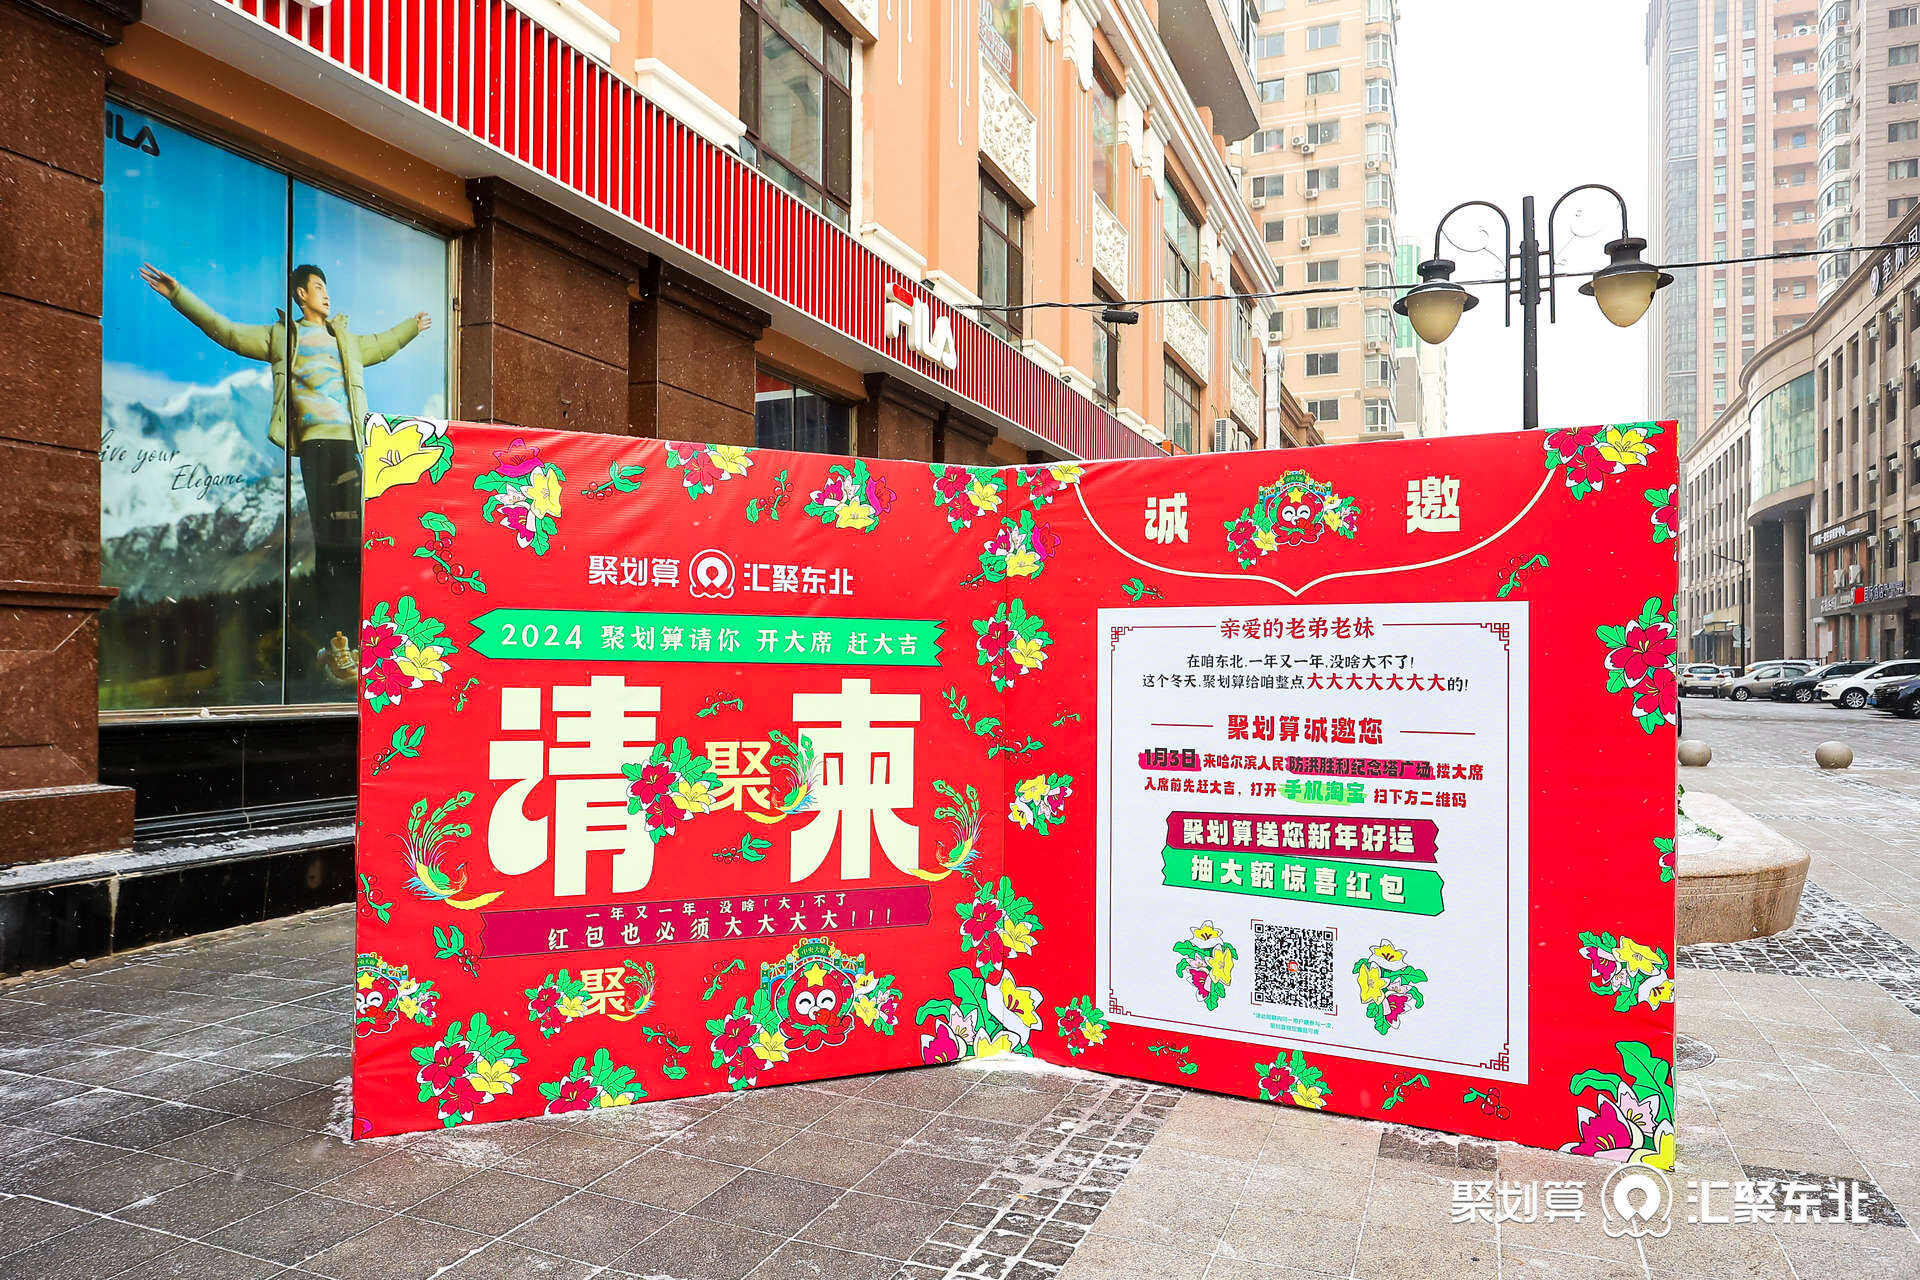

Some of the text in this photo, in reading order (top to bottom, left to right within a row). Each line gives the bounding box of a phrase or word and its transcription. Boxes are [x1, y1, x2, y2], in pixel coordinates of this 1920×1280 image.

[105, 110, 160, 157] ILA
[885, 282, 957, 371] FILA
[131, 449, 181, 474] your
[171, 463, 245, 500] Elegance
[1144, 475, 1461, 545] 诚 邀
[588, 554, 854, 596] 聚划算 汇聚东北
[500, 622, 919, 657] 2024 聚划算请你 开大席 赶大吉
[1220, 616, 1376, 641] 亲爱的老弟老妹
[1227, 714, 1384, 745] 聚划算诚邀您
[705, 740, 772, 811] 聚
[1182, 818, 1416, 854] 聚划算送您新年好运
[1190, 855, 1408, 904] 抽大额惊喜红包
[580, 966, 626, 1015] 聚
